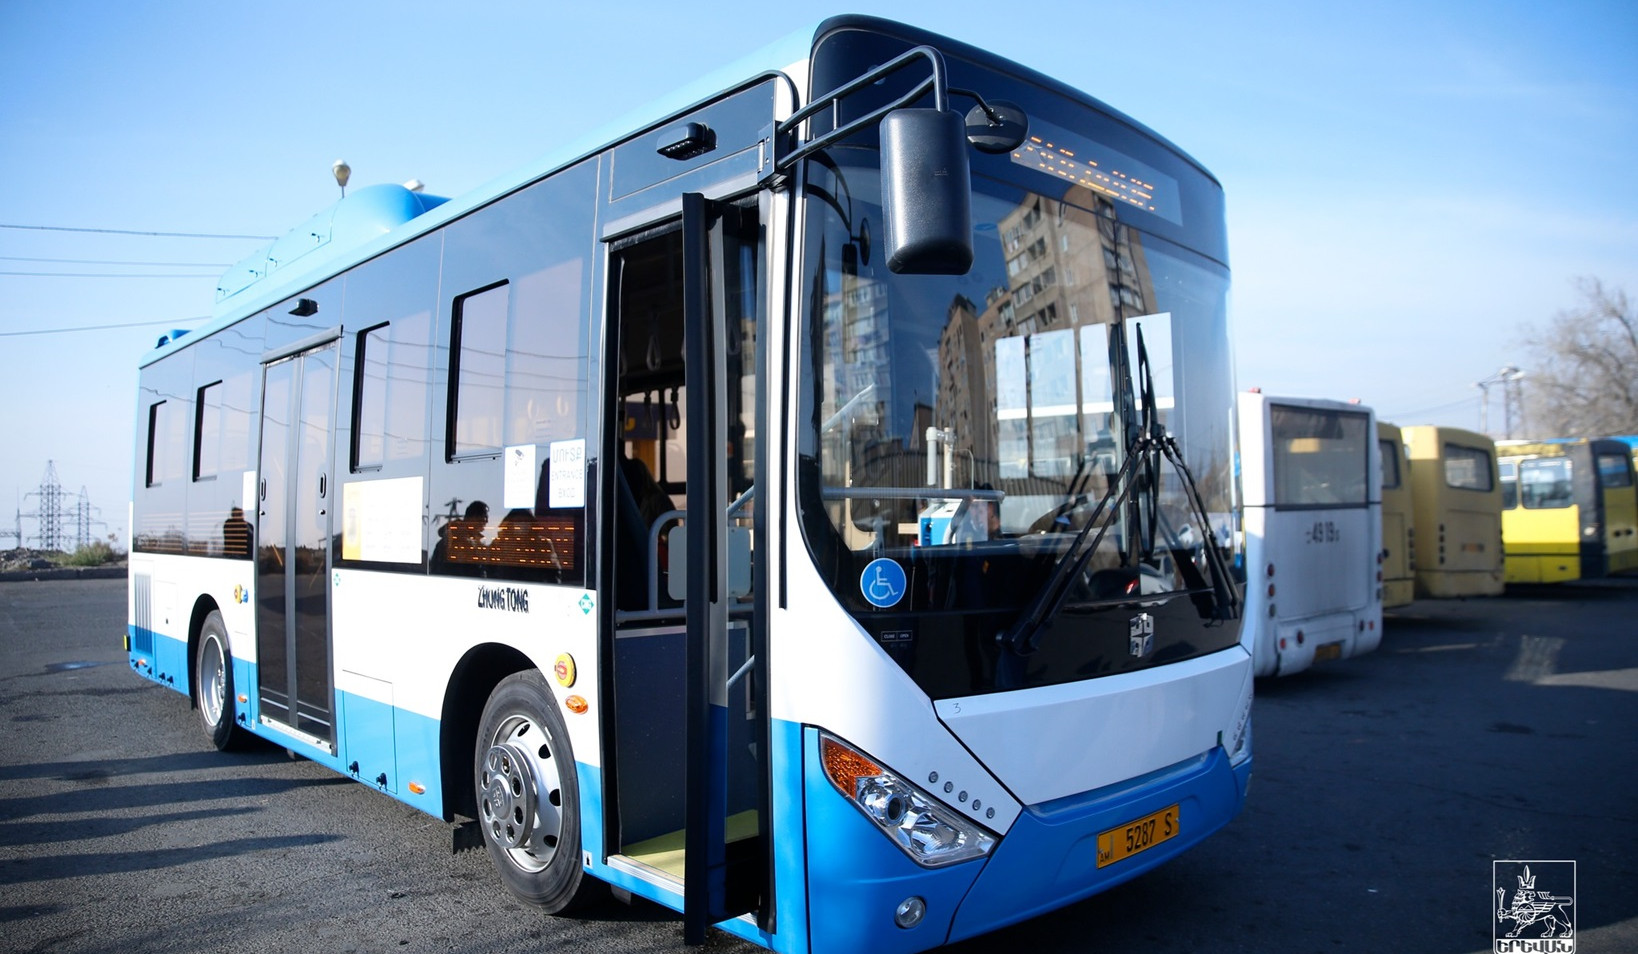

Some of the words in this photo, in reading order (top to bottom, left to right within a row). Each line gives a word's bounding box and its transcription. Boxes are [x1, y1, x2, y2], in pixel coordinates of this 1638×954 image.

[551, 468, 583, 481] ENTRANCE
[506, 587, 529, 613] TONG
[953, 702, 961, 714] 3
[1126, 819, 1156, 852] 5287
[1165, 812, 1172, 836] S
